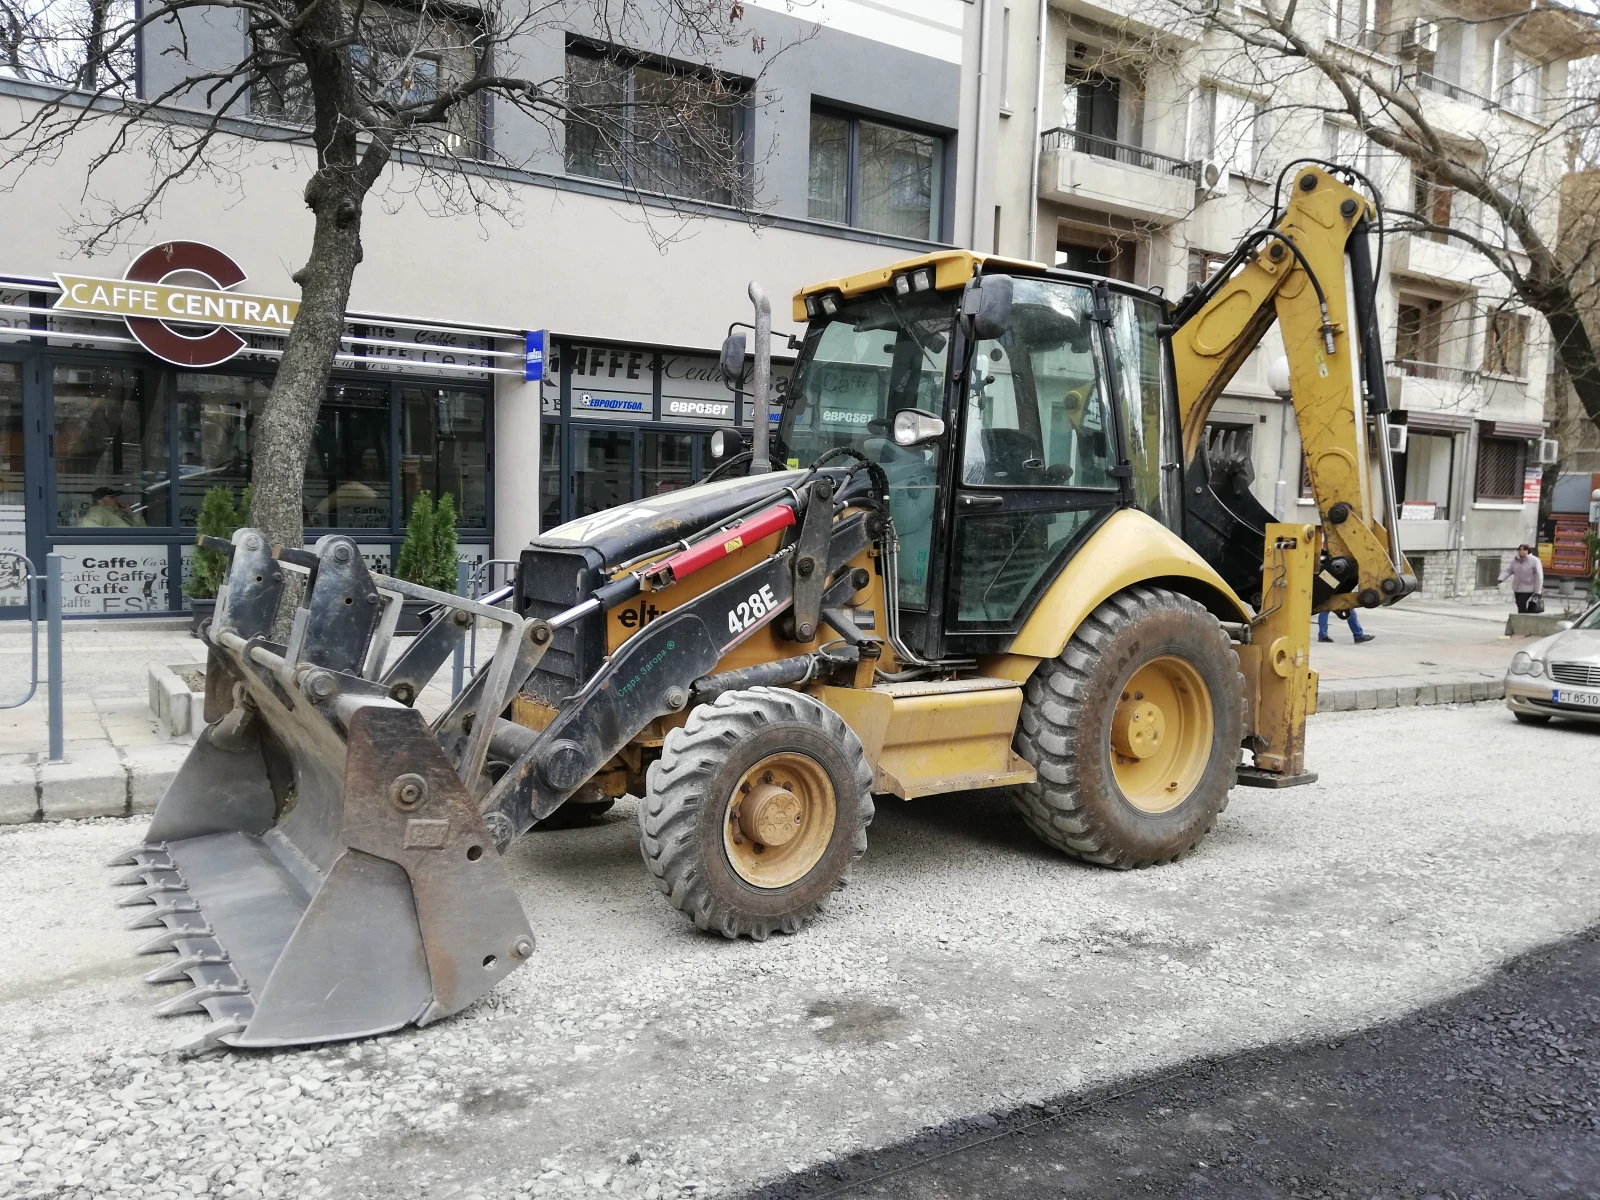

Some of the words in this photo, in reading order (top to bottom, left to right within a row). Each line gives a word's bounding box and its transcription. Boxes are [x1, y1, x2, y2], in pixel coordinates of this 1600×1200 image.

[71, 283, 158, 311] CAFFE
[167, 293, 295, 325] CENTRAL
[414, 329, 458, 347] Caffe
[82, 557, 138, 569] Caffe
[60, 570, 100, 582] Caffe
[74, 582, 129, 595] Caffe
[61, 596, 91, 608] Caffe
[728, 583, 779, 634] 428E
[617, 674, 641, 697] Стара
[640, 648, 668, 675] Загора
[1573, 693, 1599, 705] 8510
